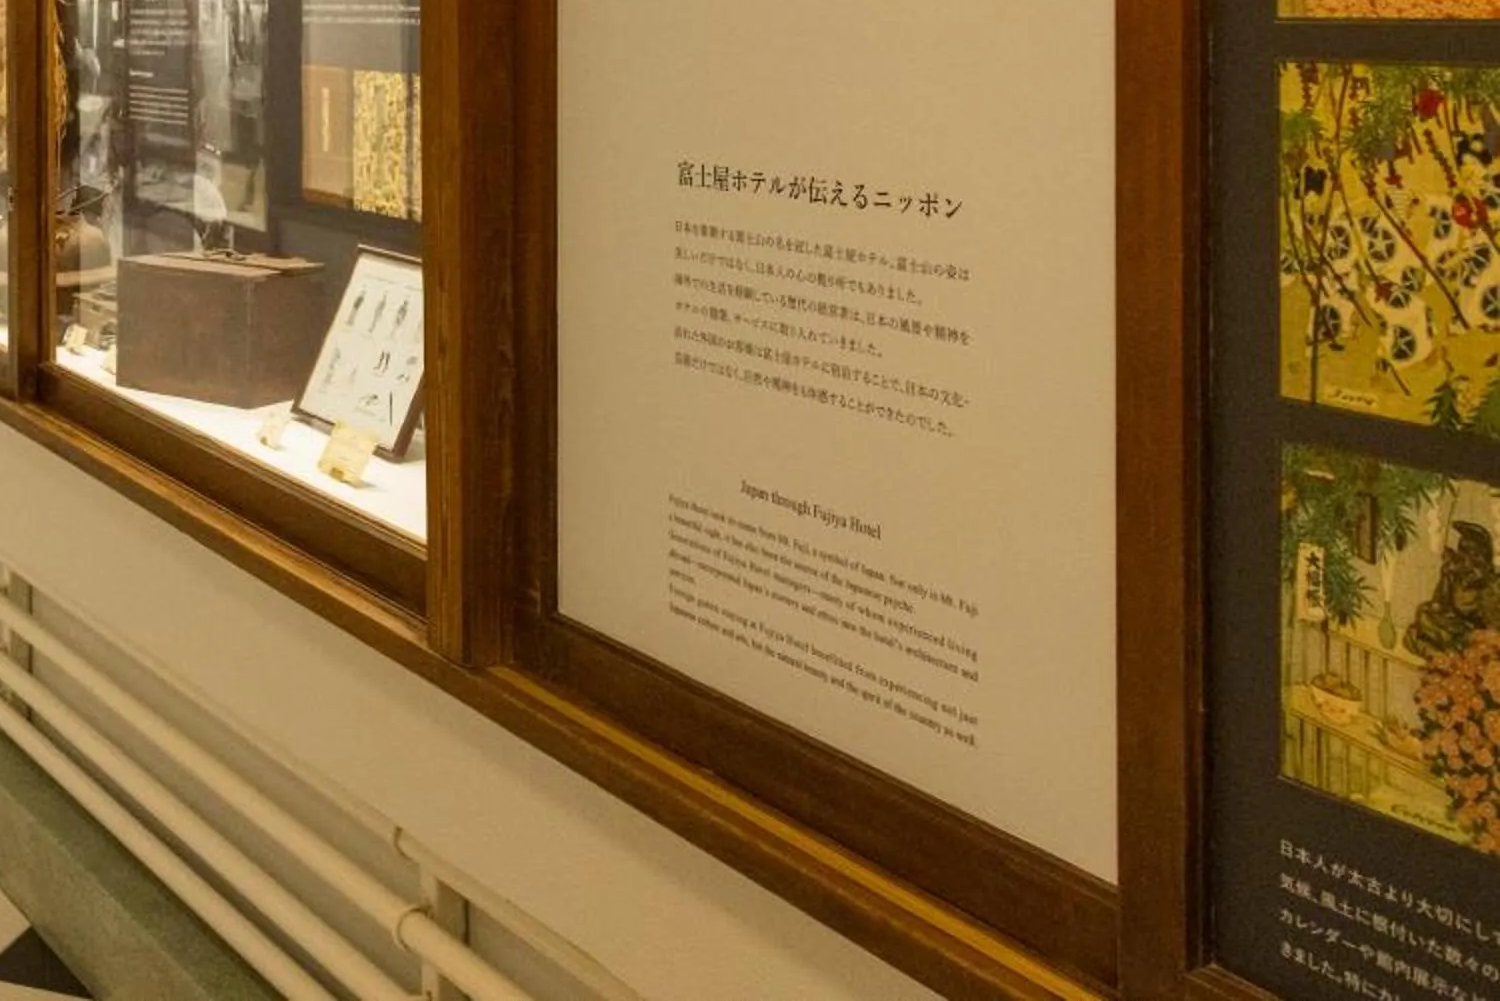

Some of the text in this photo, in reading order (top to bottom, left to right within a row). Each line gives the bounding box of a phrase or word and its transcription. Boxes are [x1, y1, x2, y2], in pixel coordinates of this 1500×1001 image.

[677, 160, 964, 220] 富士屋ホテルが伝えるニッポン
